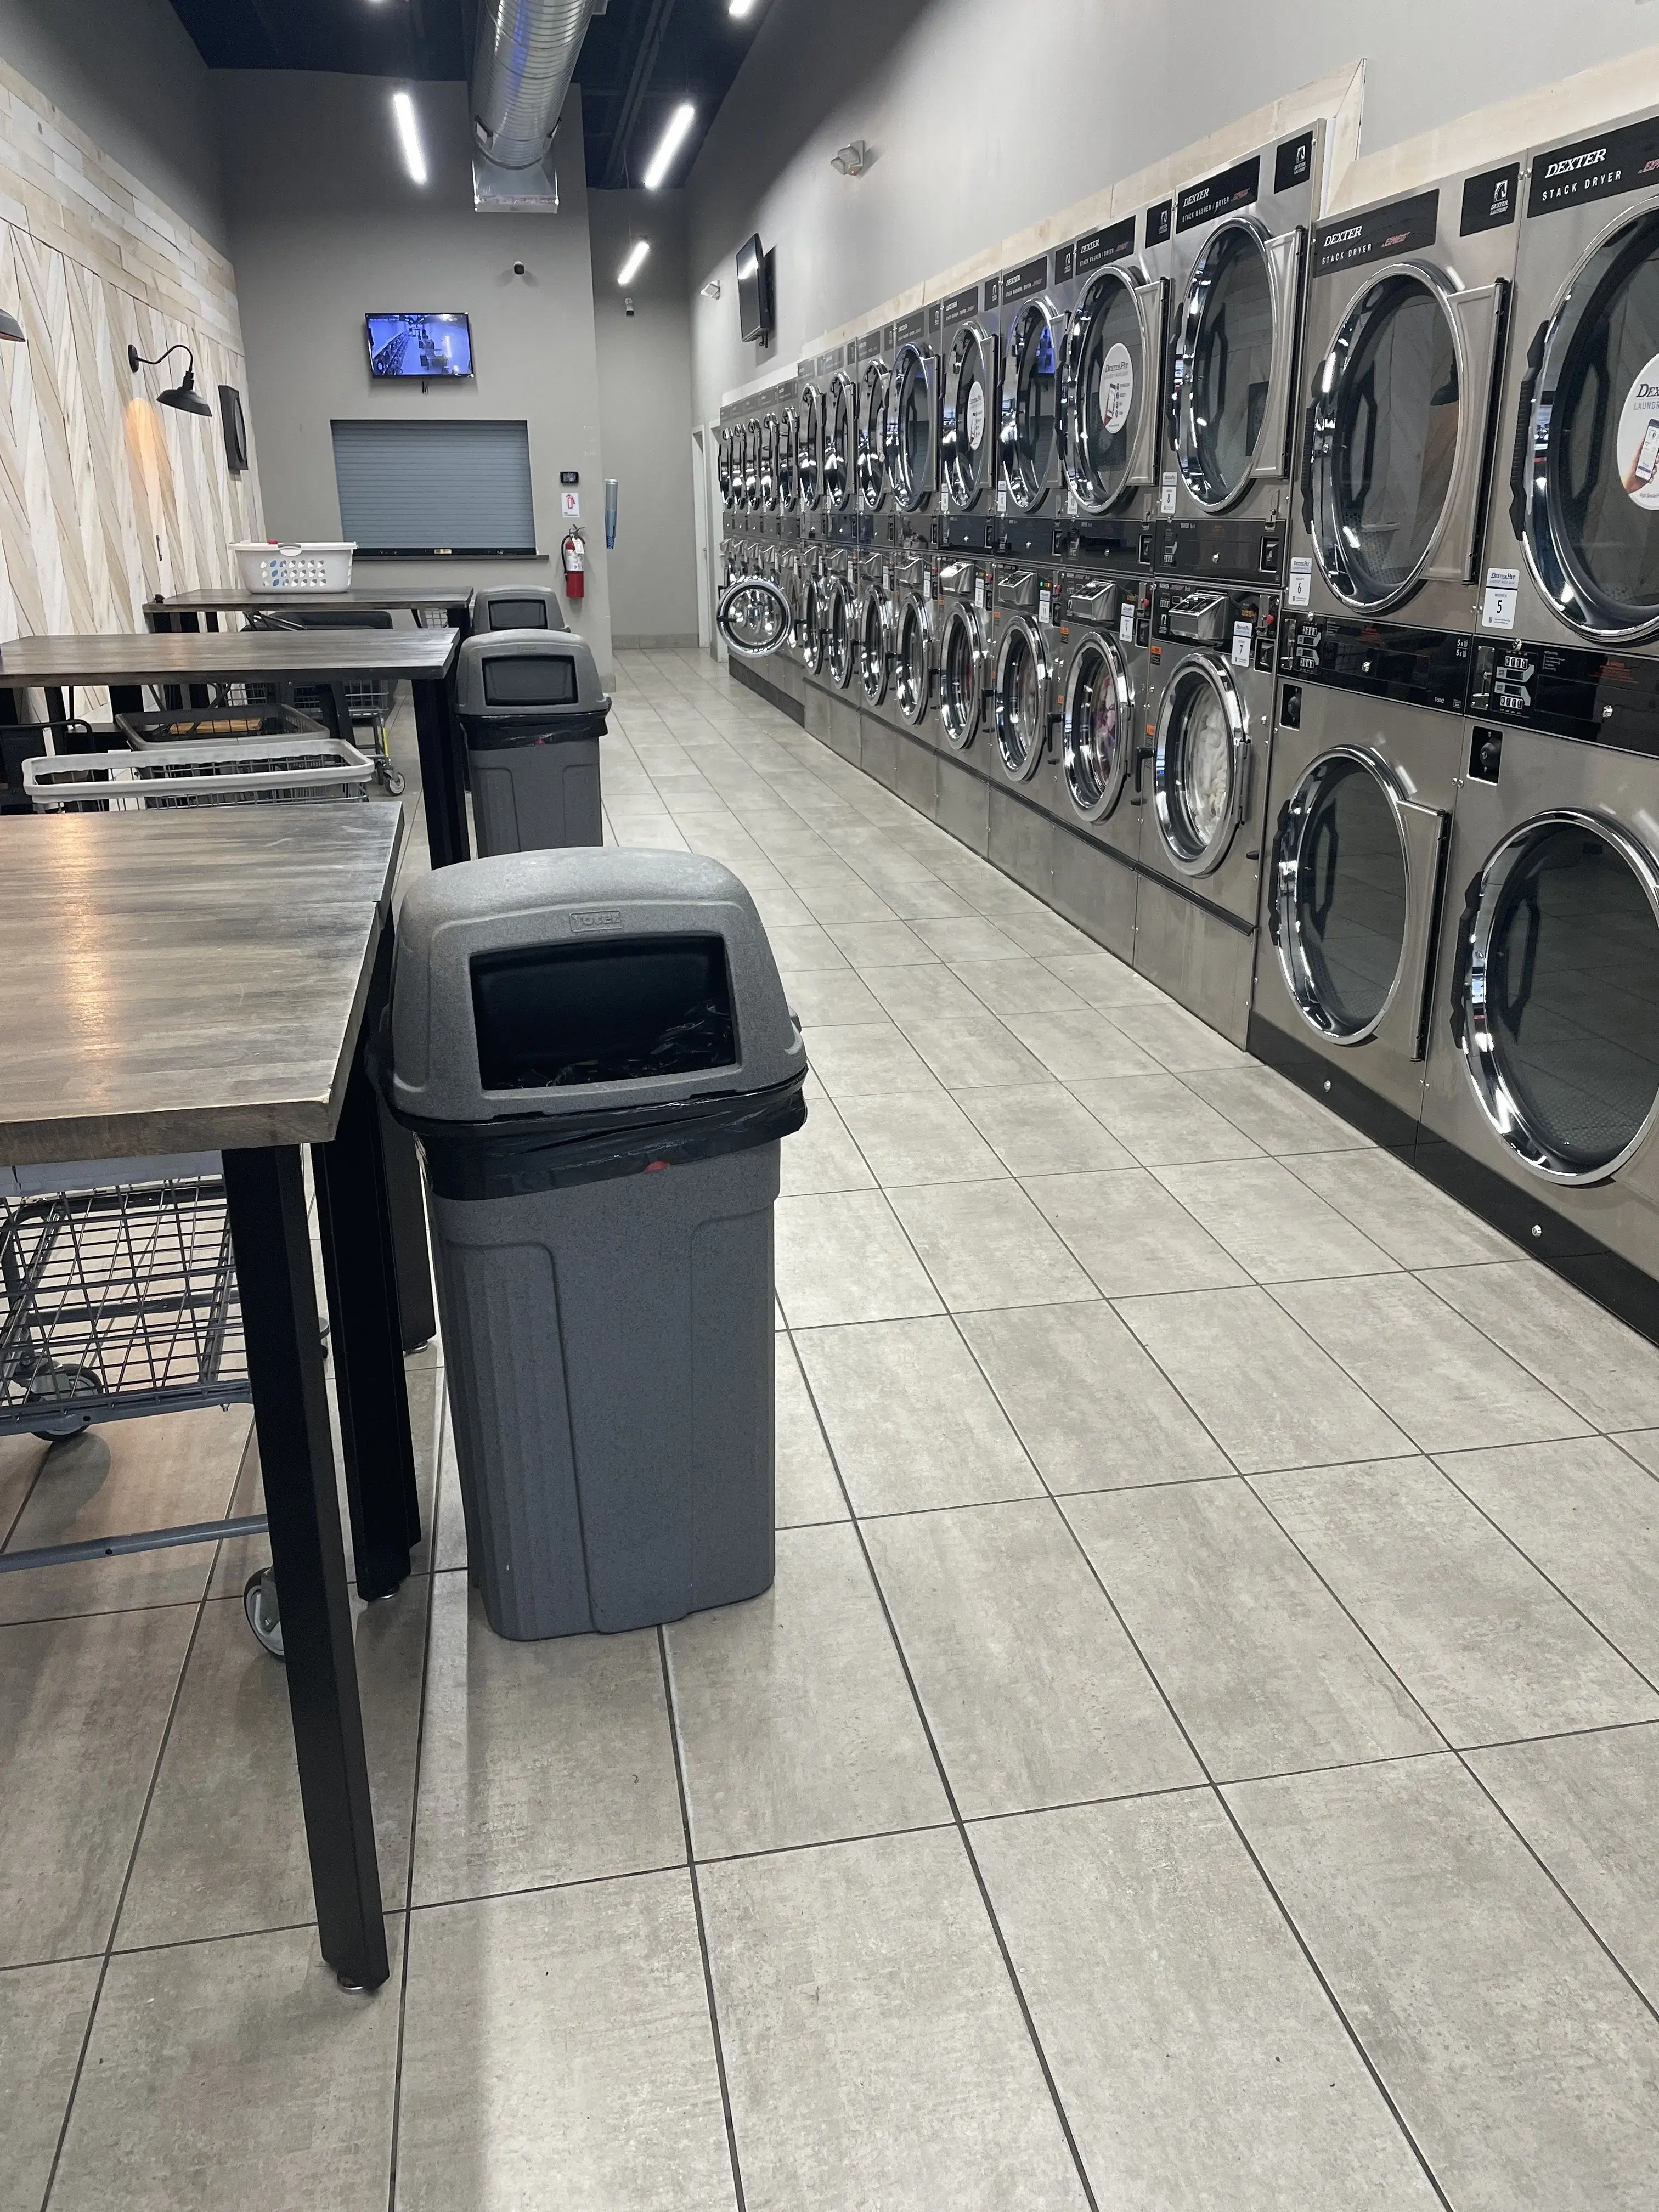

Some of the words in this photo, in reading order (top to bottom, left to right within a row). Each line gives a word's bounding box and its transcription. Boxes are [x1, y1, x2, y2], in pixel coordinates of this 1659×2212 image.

[1544, 148, 1606, 178] DEXTER
[1542, 182, 1578, 201] STACK
[1584, 170, 1622, 189] DRYER
[1183, 188, 1209, 207] DEXTER
[1323, 225, 1362, 247] DEXTER
[1080, 239, 1099, 253] DEXTER
[1322, 252, 1344, 265] STACK
[1348, 244, 1372, 258] DRYER
[1167, 493, 1170, 504] 8
[1297, 583, 1301, 594] 6
[1497, 600, 1502, 613] 5
[1240, 645, 1243, 655] 7
